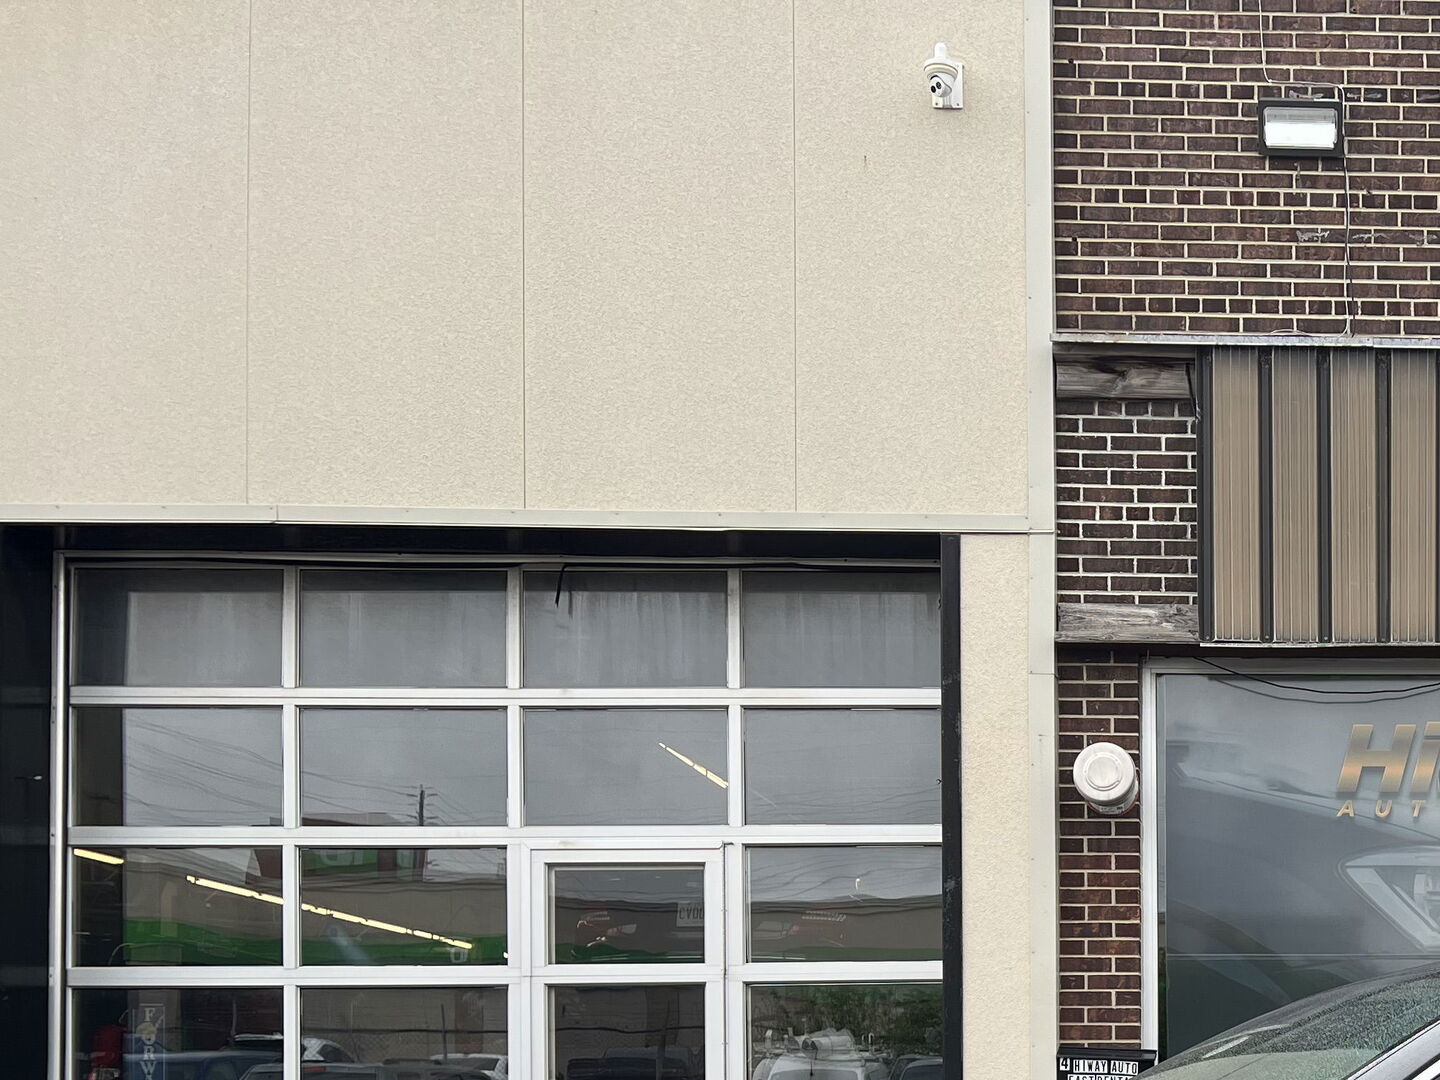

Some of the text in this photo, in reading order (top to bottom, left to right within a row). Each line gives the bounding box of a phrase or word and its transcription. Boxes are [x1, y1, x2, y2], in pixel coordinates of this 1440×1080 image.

[1060, 1058, 1138, 1074] 4 HIWAY AUTO
